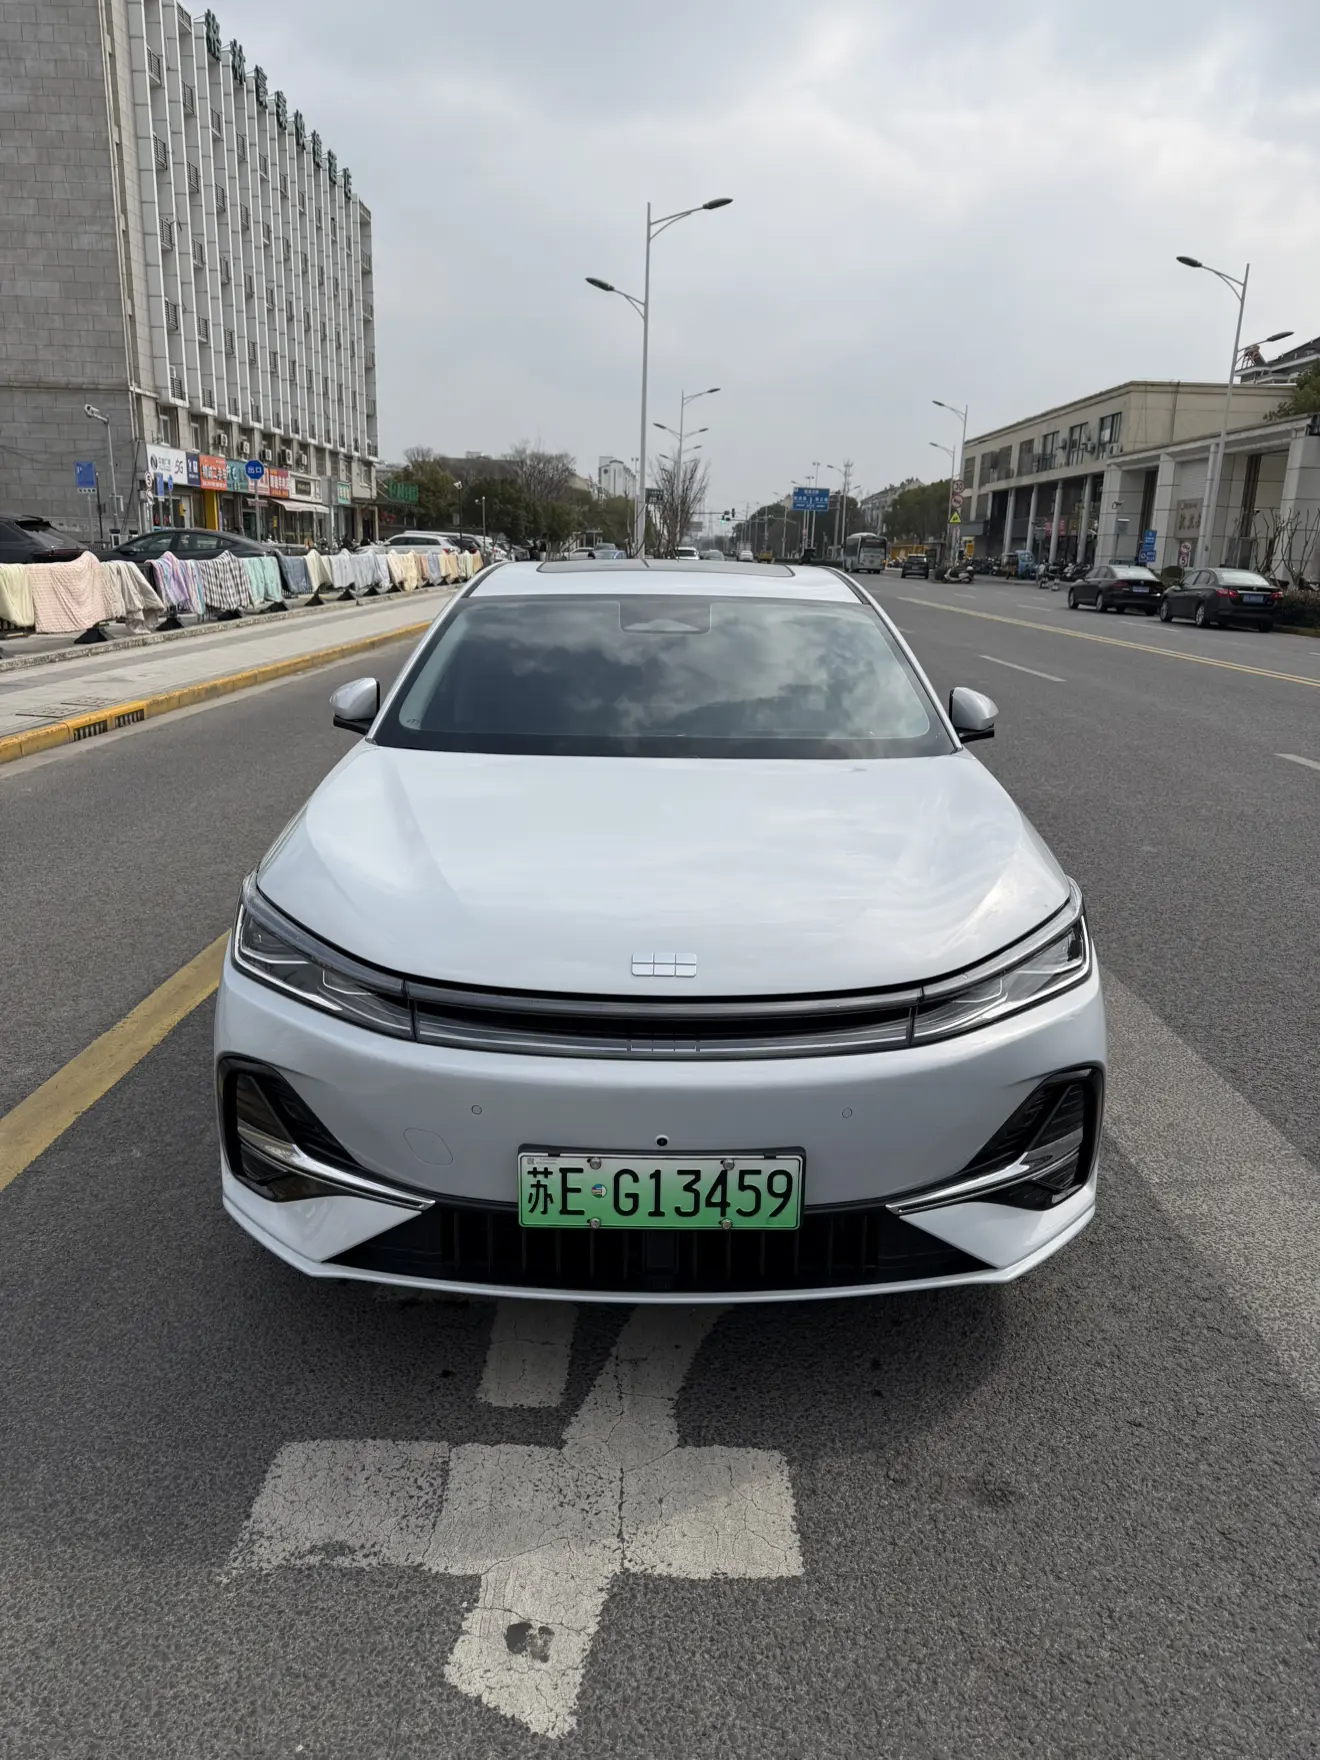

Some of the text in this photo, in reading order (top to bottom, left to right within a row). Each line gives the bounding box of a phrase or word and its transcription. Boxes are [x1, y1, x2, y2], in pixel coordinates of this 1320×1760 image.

[174, 457, 184, 474] 5G
[247, 465, 262, 475] 出口
[526, 1166, 794, 1218] 苏E G13459
